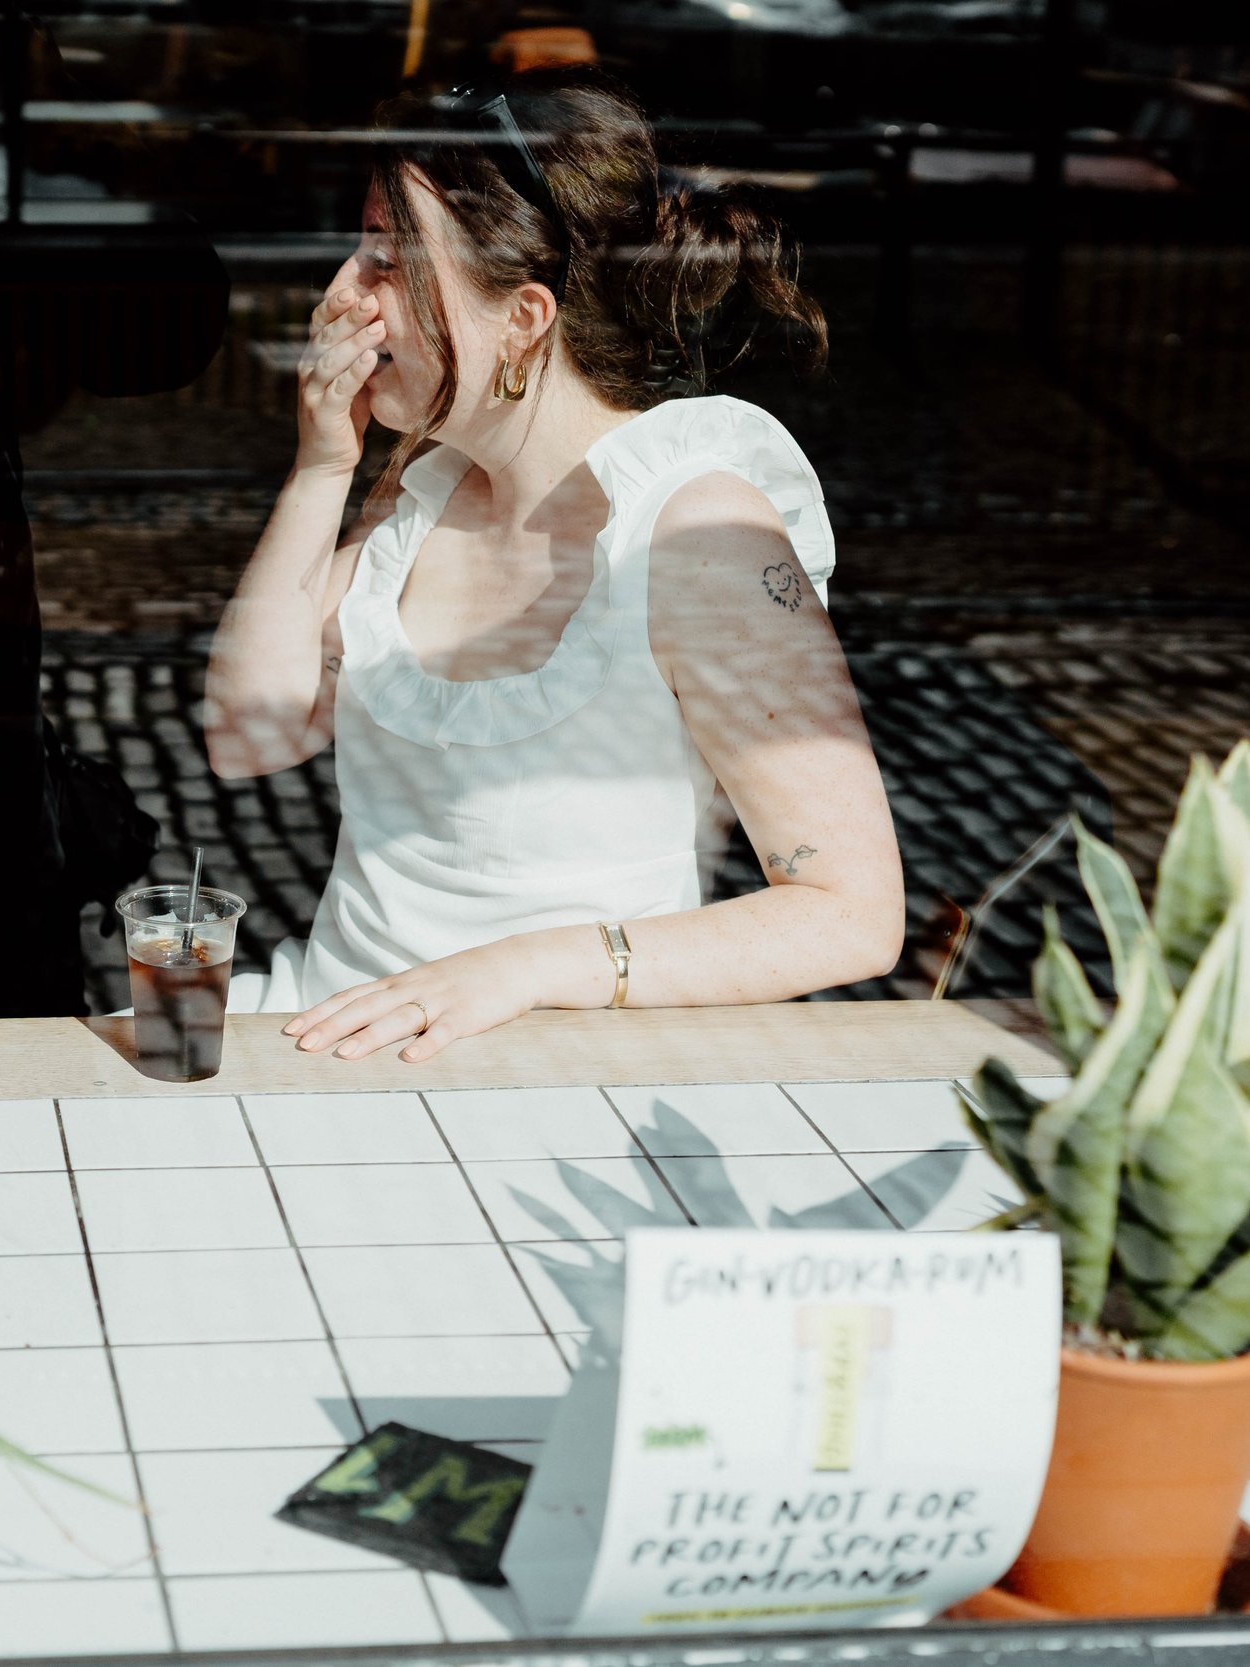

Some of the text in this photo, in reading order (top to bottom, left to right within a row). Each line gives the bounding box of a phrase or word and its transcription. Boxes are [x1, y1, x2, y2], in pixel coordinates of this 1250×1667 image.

[667, 1489, 974, 1527] THE NOT FOR
[630, 1527, 990, 1567] PROFIT SPIRITS
[664, 1567, 931, 1598] COMPANY
